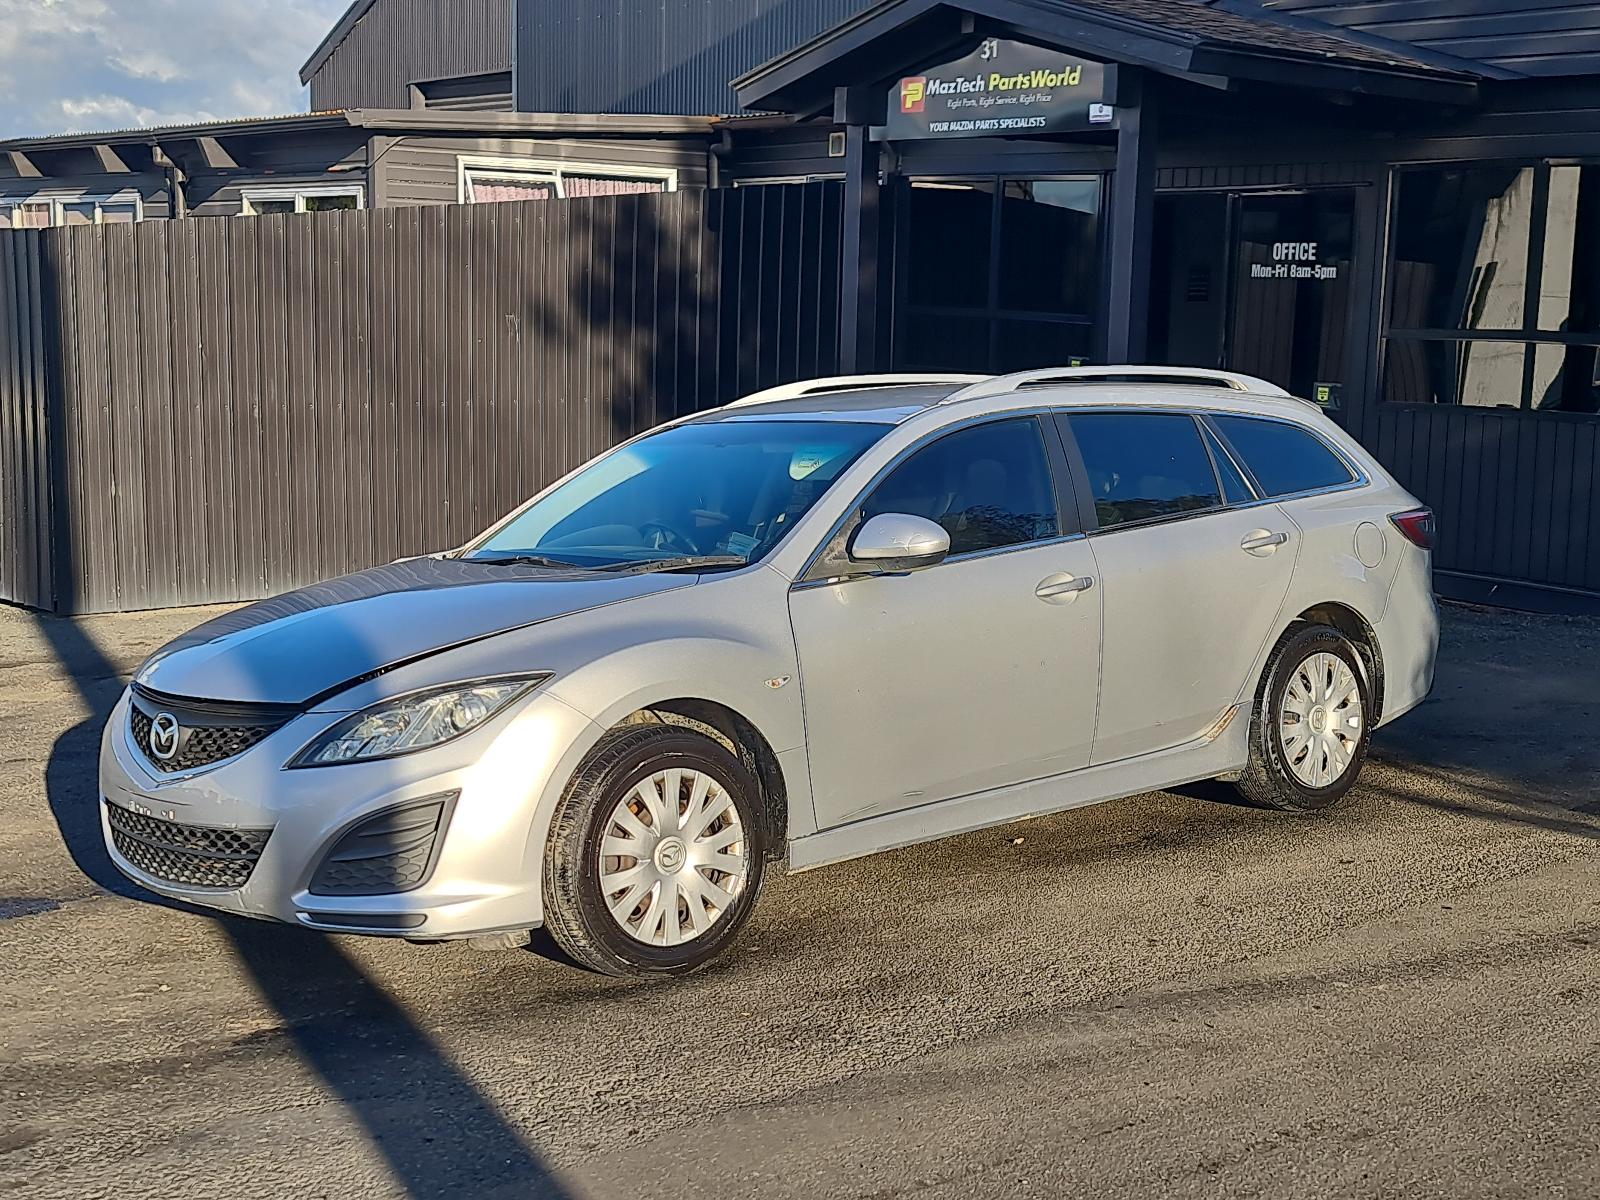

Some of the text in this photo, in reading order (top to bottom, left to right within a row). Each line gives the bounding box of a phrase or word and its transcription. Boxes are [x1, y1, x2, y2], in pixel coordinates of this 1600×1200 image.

[980, 40, 998, 59] 31
[926, 65, 1081, 95] MazTech PartsWorld
[929, 117, 1046, 132] YOUR MAZDA PARTS SPECIALISTS
[1272, 242, 1317, 261] OFFICE
[1251, 264, 1337, 280] Mon-Fri 8am-5pm
